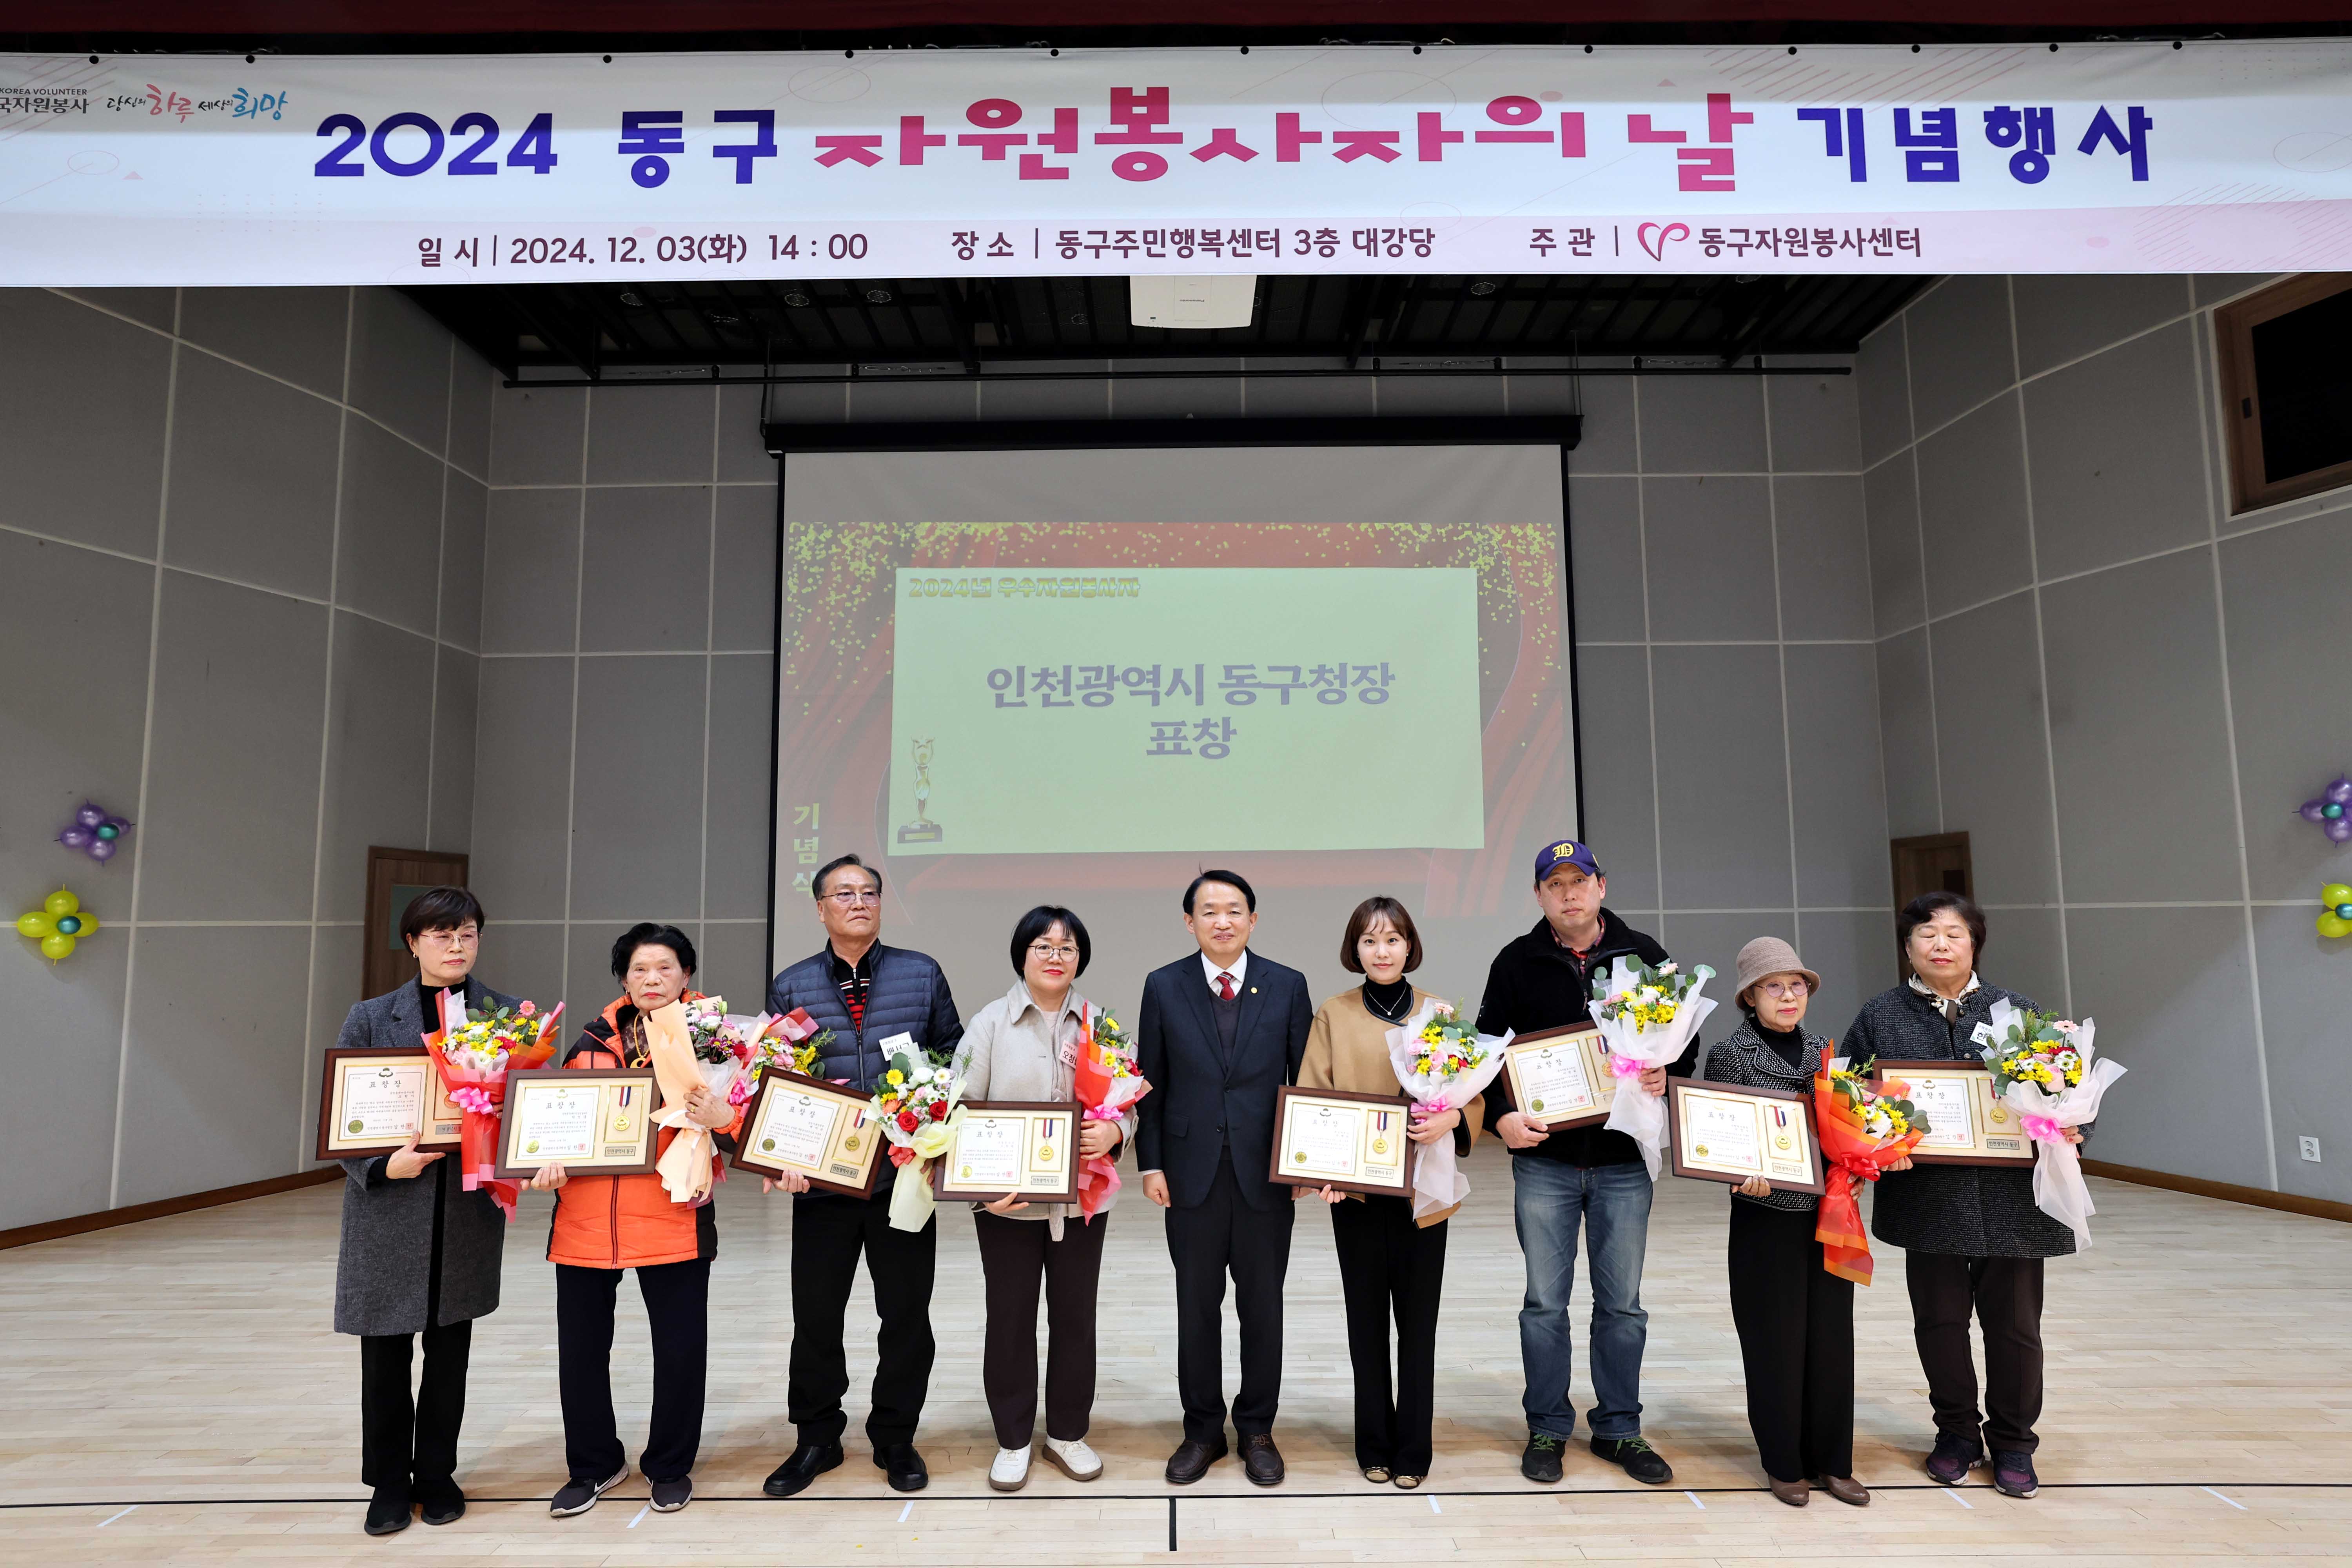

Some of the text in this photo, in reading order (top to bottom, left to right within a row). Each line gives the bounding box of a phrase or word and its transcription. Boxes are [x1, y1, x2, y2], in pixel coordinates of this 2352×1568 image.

[107, 84, 289, 123] 당신의 하루 세상의 희망
[314, 87, 2153, 191] 2024 동구 자원봉사자의 날 기념행사
[510, 238, 595, 264] 2024.
[608, 237, 645, 264] 12.
[657, 234, 747, 264] 03(화)
[1056, 229, 1280, 260] 동구주민행복센터
[1294, 228, 1341, 258] 3층
[1353, 228, 1436, 258] 대강당
[1699, 228, 1921, 258] 동구자원봉사센터
[909, 577, 1140, 598] 2024년 우수자원봉사자
[987, 662, 1396, 708] 인천광역시 동구청장
[1146, 717, 1238, 759] 표창
